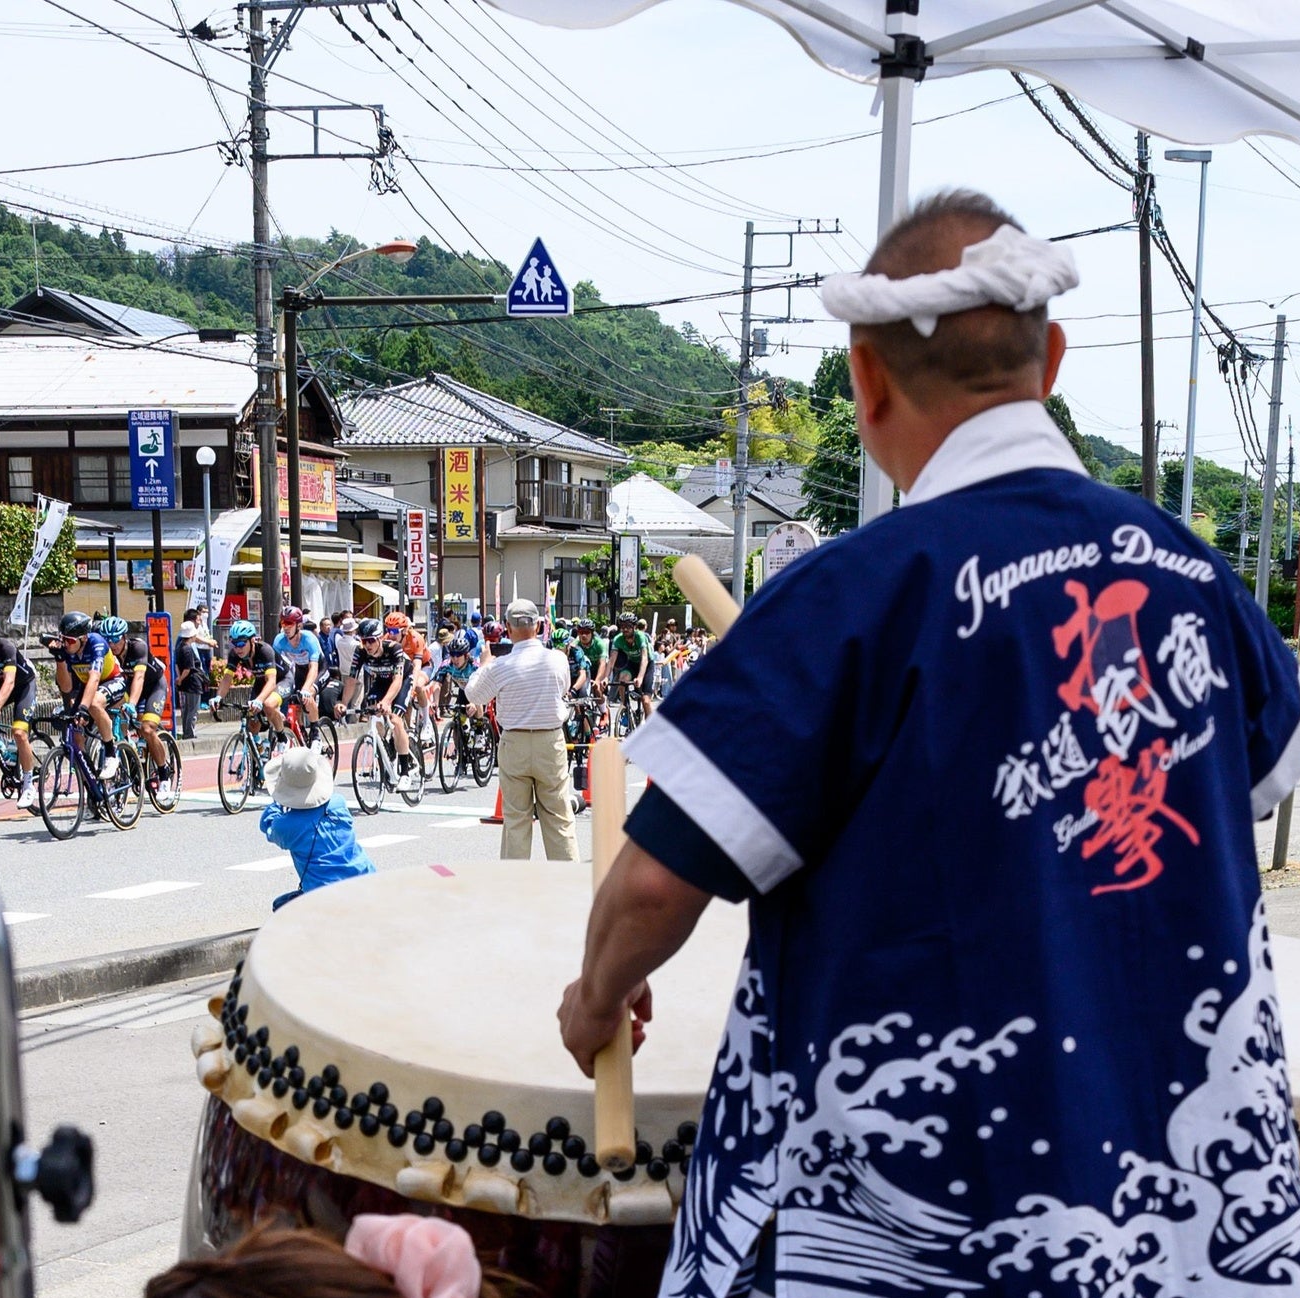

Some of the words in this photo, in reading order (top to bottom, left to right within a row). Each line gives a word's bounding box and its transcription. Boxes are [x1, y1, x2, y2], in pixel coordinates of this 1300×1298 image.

[449, 451, 469, 473] 酒
[449, 483, 470, 504] 米
[449, 510, 472, 537] 激安
[200, 565, 221, 576] Tur
[409, 530, 425, 596] プロパンの店
[195, 583, 223, 596] Jaan
[954, 541, 1103, 639] Japanese
[1111, 524, 1216, 583] Drum
